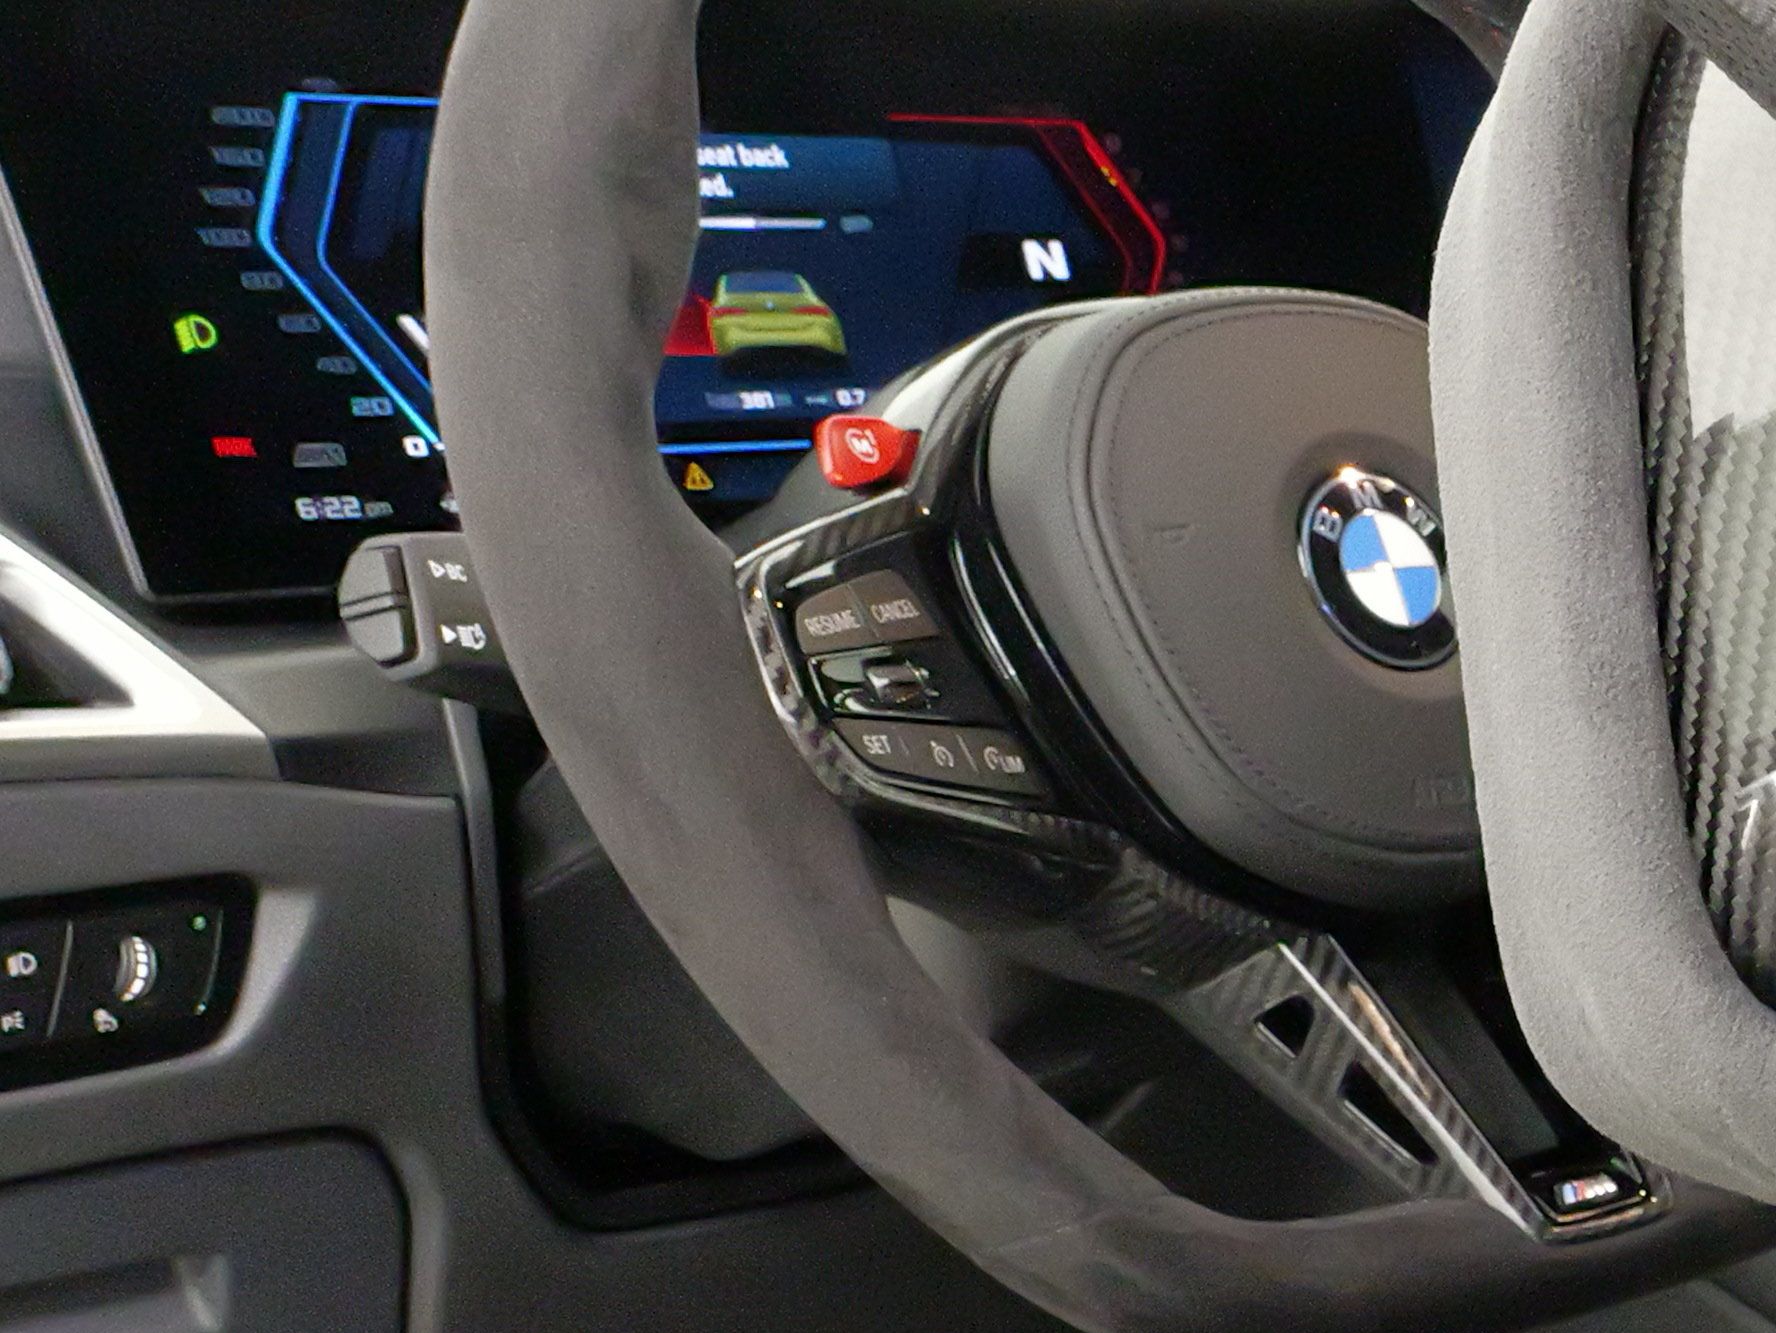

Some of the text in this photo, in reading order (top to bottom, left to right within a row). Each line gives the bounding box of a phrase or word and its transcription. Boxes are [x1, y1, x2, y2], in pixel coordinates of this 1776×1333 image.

[1020, 238, 1072, 282] N
[294, 495, 363, 521] 6:22
[1312, 480, 1438, 544] BMW
[803, 599, 921, 637] RESUME CANCEL
[862, 734, 893, 755] SET
